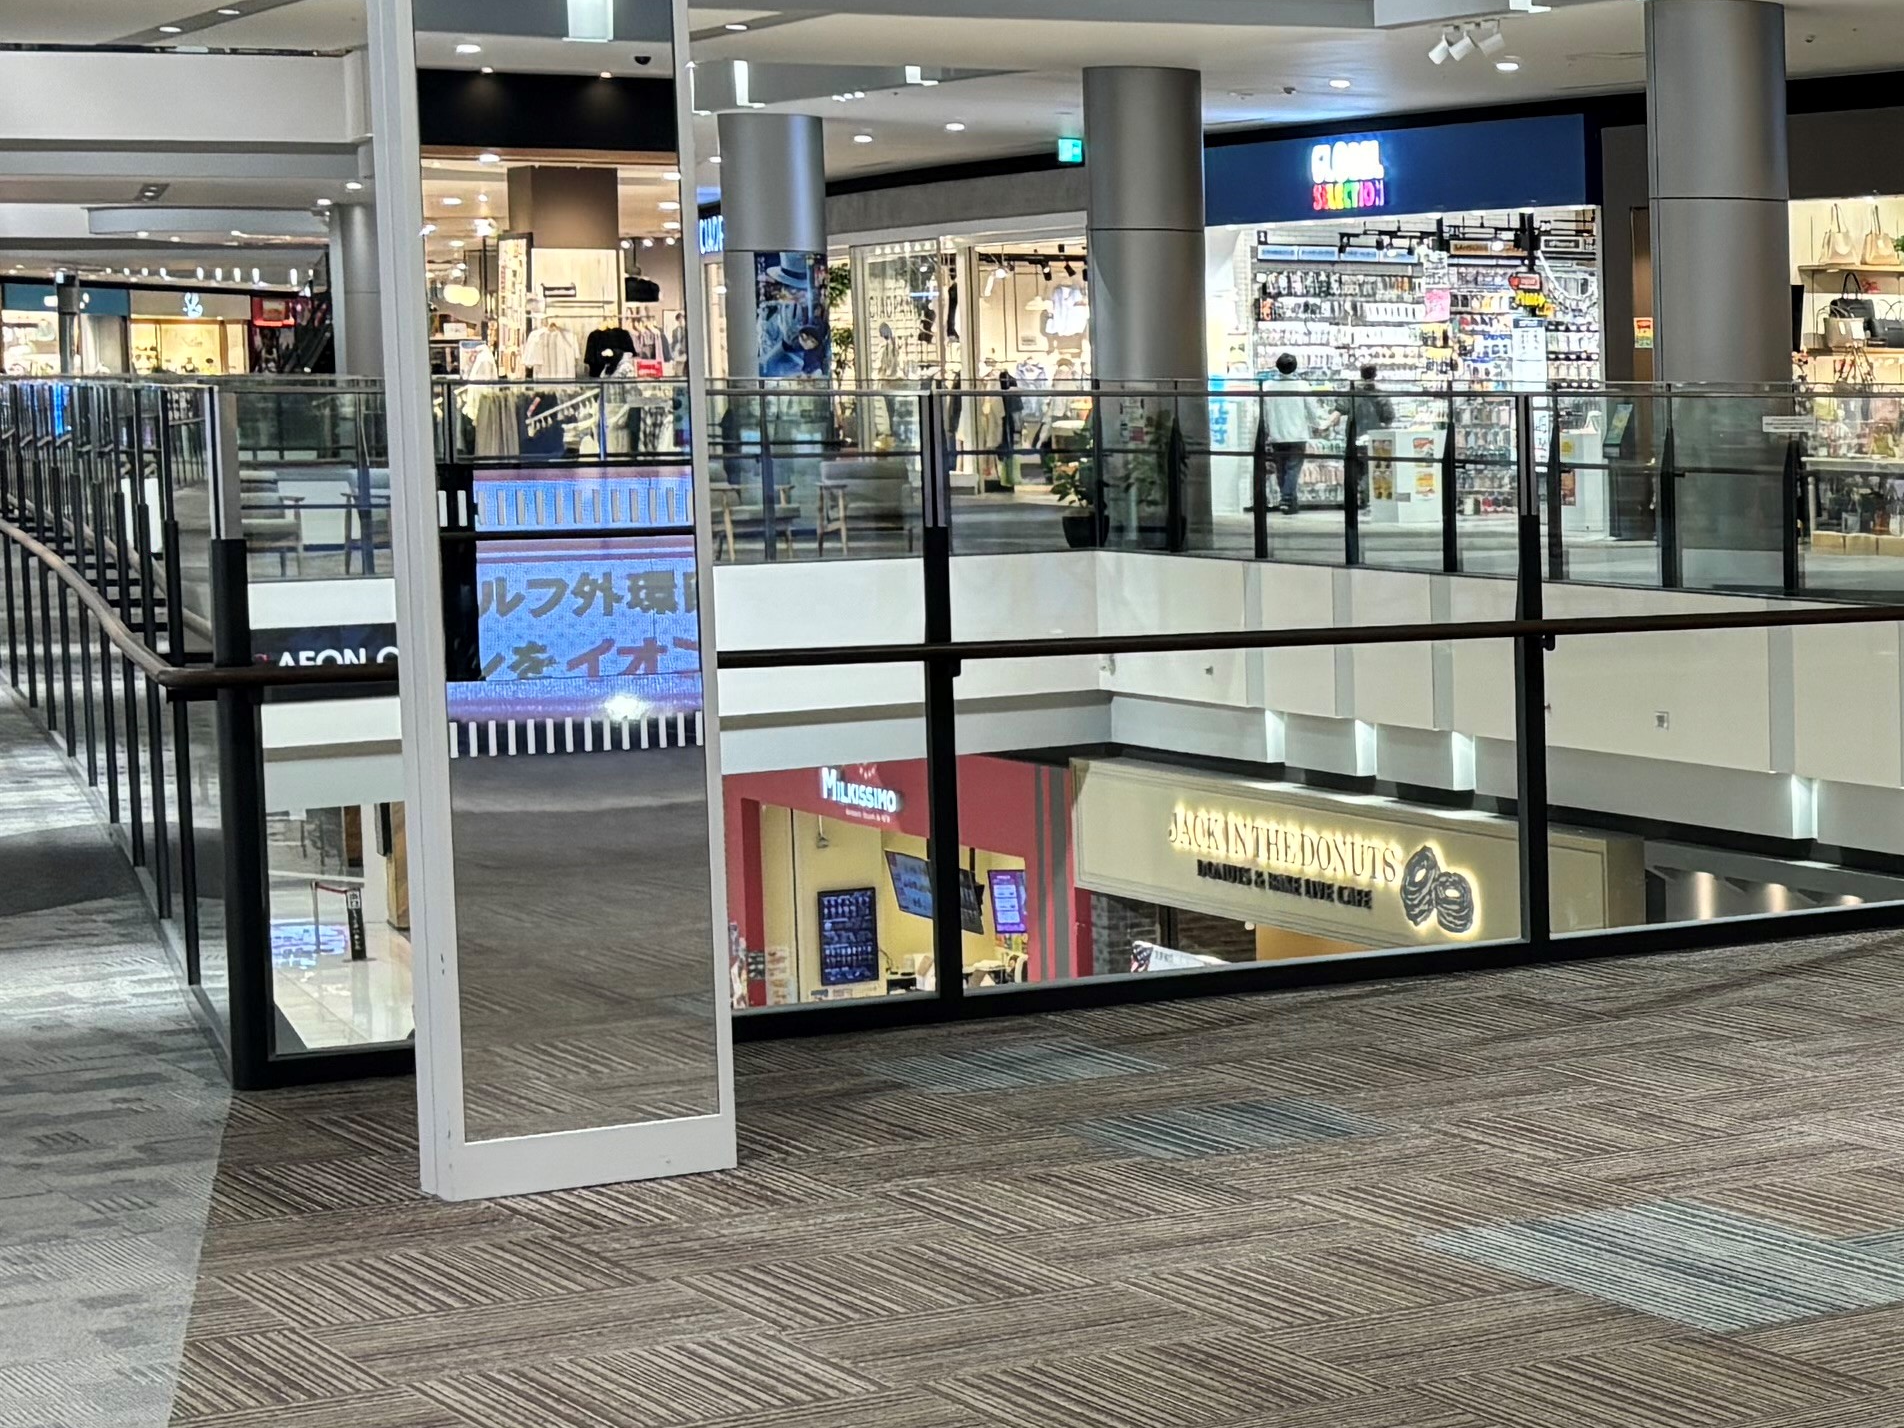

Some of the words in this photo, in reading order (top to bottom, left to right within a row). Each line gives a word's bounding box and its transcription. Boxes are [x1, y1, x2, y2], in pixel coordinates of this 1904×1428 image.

[1168, 811, 1220, 851] JACK
[1225, 820, 1247, 855] IN
[1251, 825, 1297, 865] THE
[1300, 833, 1397, 883] DONUTS
